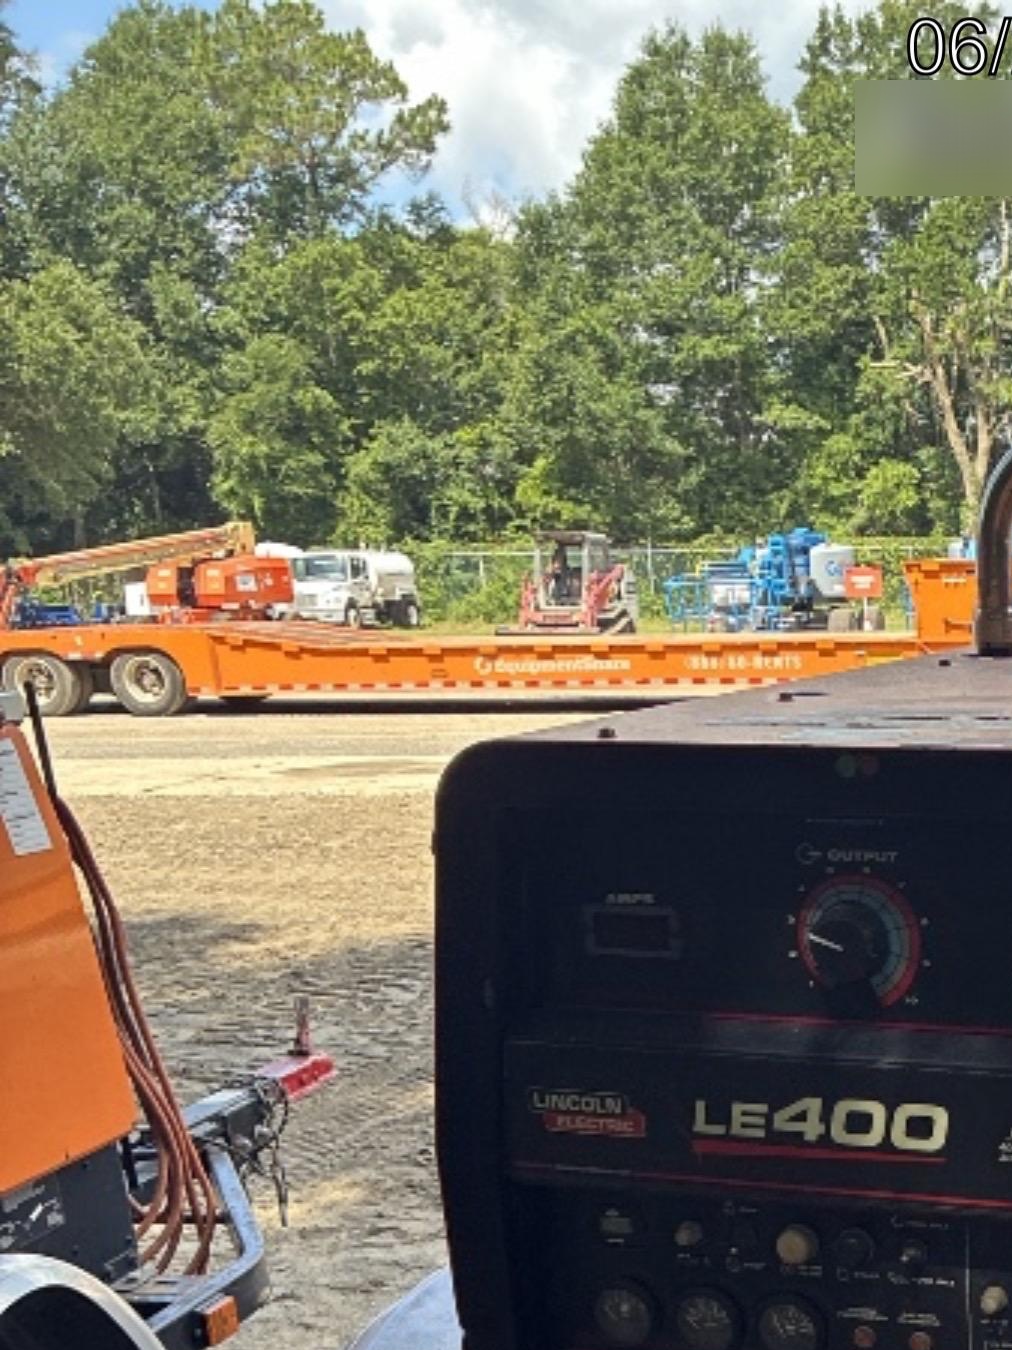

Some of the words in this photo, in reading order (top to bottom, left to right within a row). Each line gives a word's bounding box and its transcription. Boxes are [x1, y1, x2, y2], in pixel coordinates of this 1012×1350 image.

[826, 847, 899, 863] OUTPUT
[532, 1090, 623, 1114] LINCOLN
[556, 1114, 635, 1133] ELECTRIC
[692, 1096, 950, 1153] LE400
